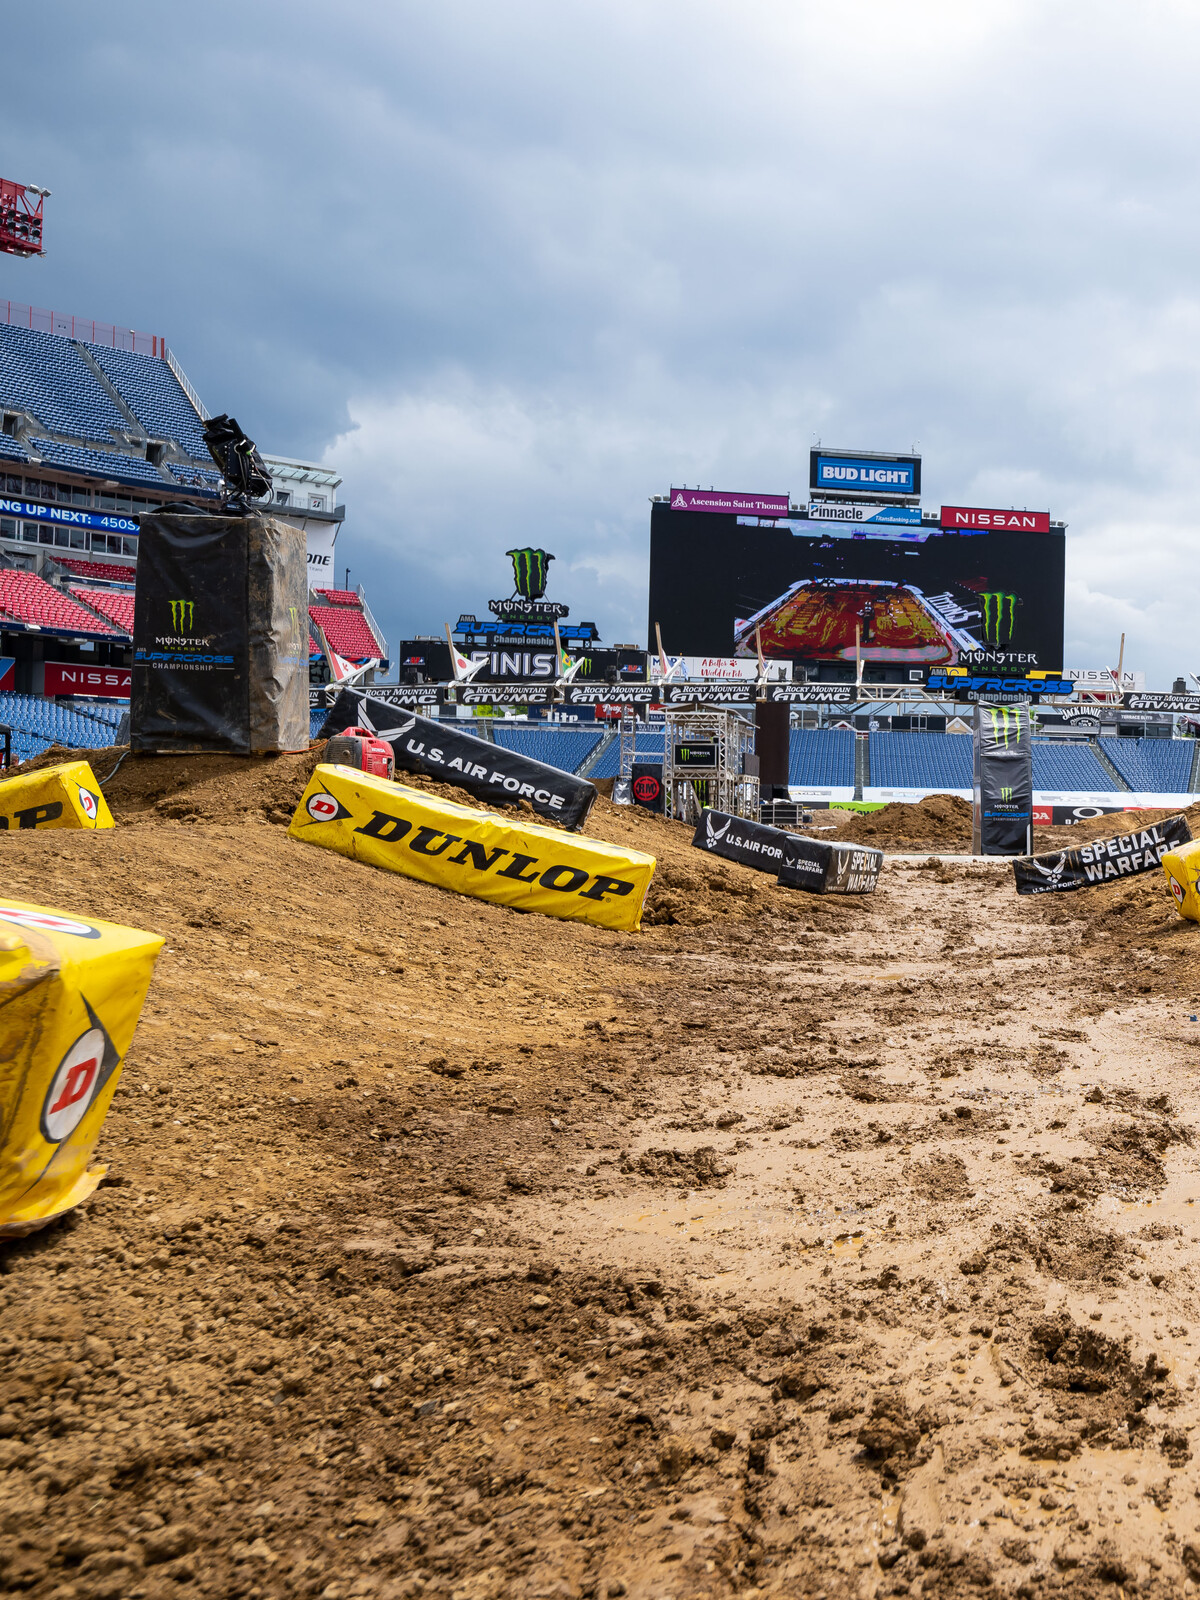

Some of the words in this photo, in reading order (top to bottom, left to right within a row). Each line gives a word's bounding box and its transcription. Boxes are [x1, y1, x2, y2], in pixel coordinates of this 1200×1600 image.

[823, 466, 858, 481] BUD
[860, 469, 909, 484] LIGHT
[690, 498, 731, 507] Ascension
[733, 499, 754, 508] Saint
[755, 501, 788, 511] Thomas
[26, 503, 46, 516] UP
[50, 507, 92, 525] NEXT:
[811, 504, 863, 520] Pinnacle
[875, 515, 920, 524] TitansBanking.com
[955, 512, 1036, 528] NISSAN
[489, 600, 562, 614] MONSTER
[456, 622, 592, 638] SUPERCROSS
[155, 636, 209, 647] MONSTER
[493, 634, 554, 646] Championship
[134, 652, 234, 663] SUPERCROSS
[960, 650, 1038, 665] MONSTER
[152, 663, 213, 671] CHAMPIONSHIP
[931, 668, 948, 676] AMA
[62, 671, 131, 686] NISSA
[1069, 670, 1134, 681] NISSN
[785, 685, 811, 693] ROCKY
[926, 677, 1076, 694] SUPERCROSS
[967, 691, 1033, 703] Championship
[1141, 693, 1162, 701] ROCKY
[1164, 695, 1200, 703] MOUNTAIN
[1062, 707, 1080, 721] JACK
[406, 738, 444, 763] U.S.
[449, 757, 487, 780] AIR
[489, 771, 566, 810] FORCE
[726, 833, 743, 847] U.S.
[743, 839, 760, 852] AIR
[761, 843, 783, 859] FOR
[1080, 827, 1165, 863] SPECIAL
[354, 809, 635, 901] DUNLOP
[796, 864, 823, 874] WARFARE
[797, 859, 820, 868] SPECIAL
